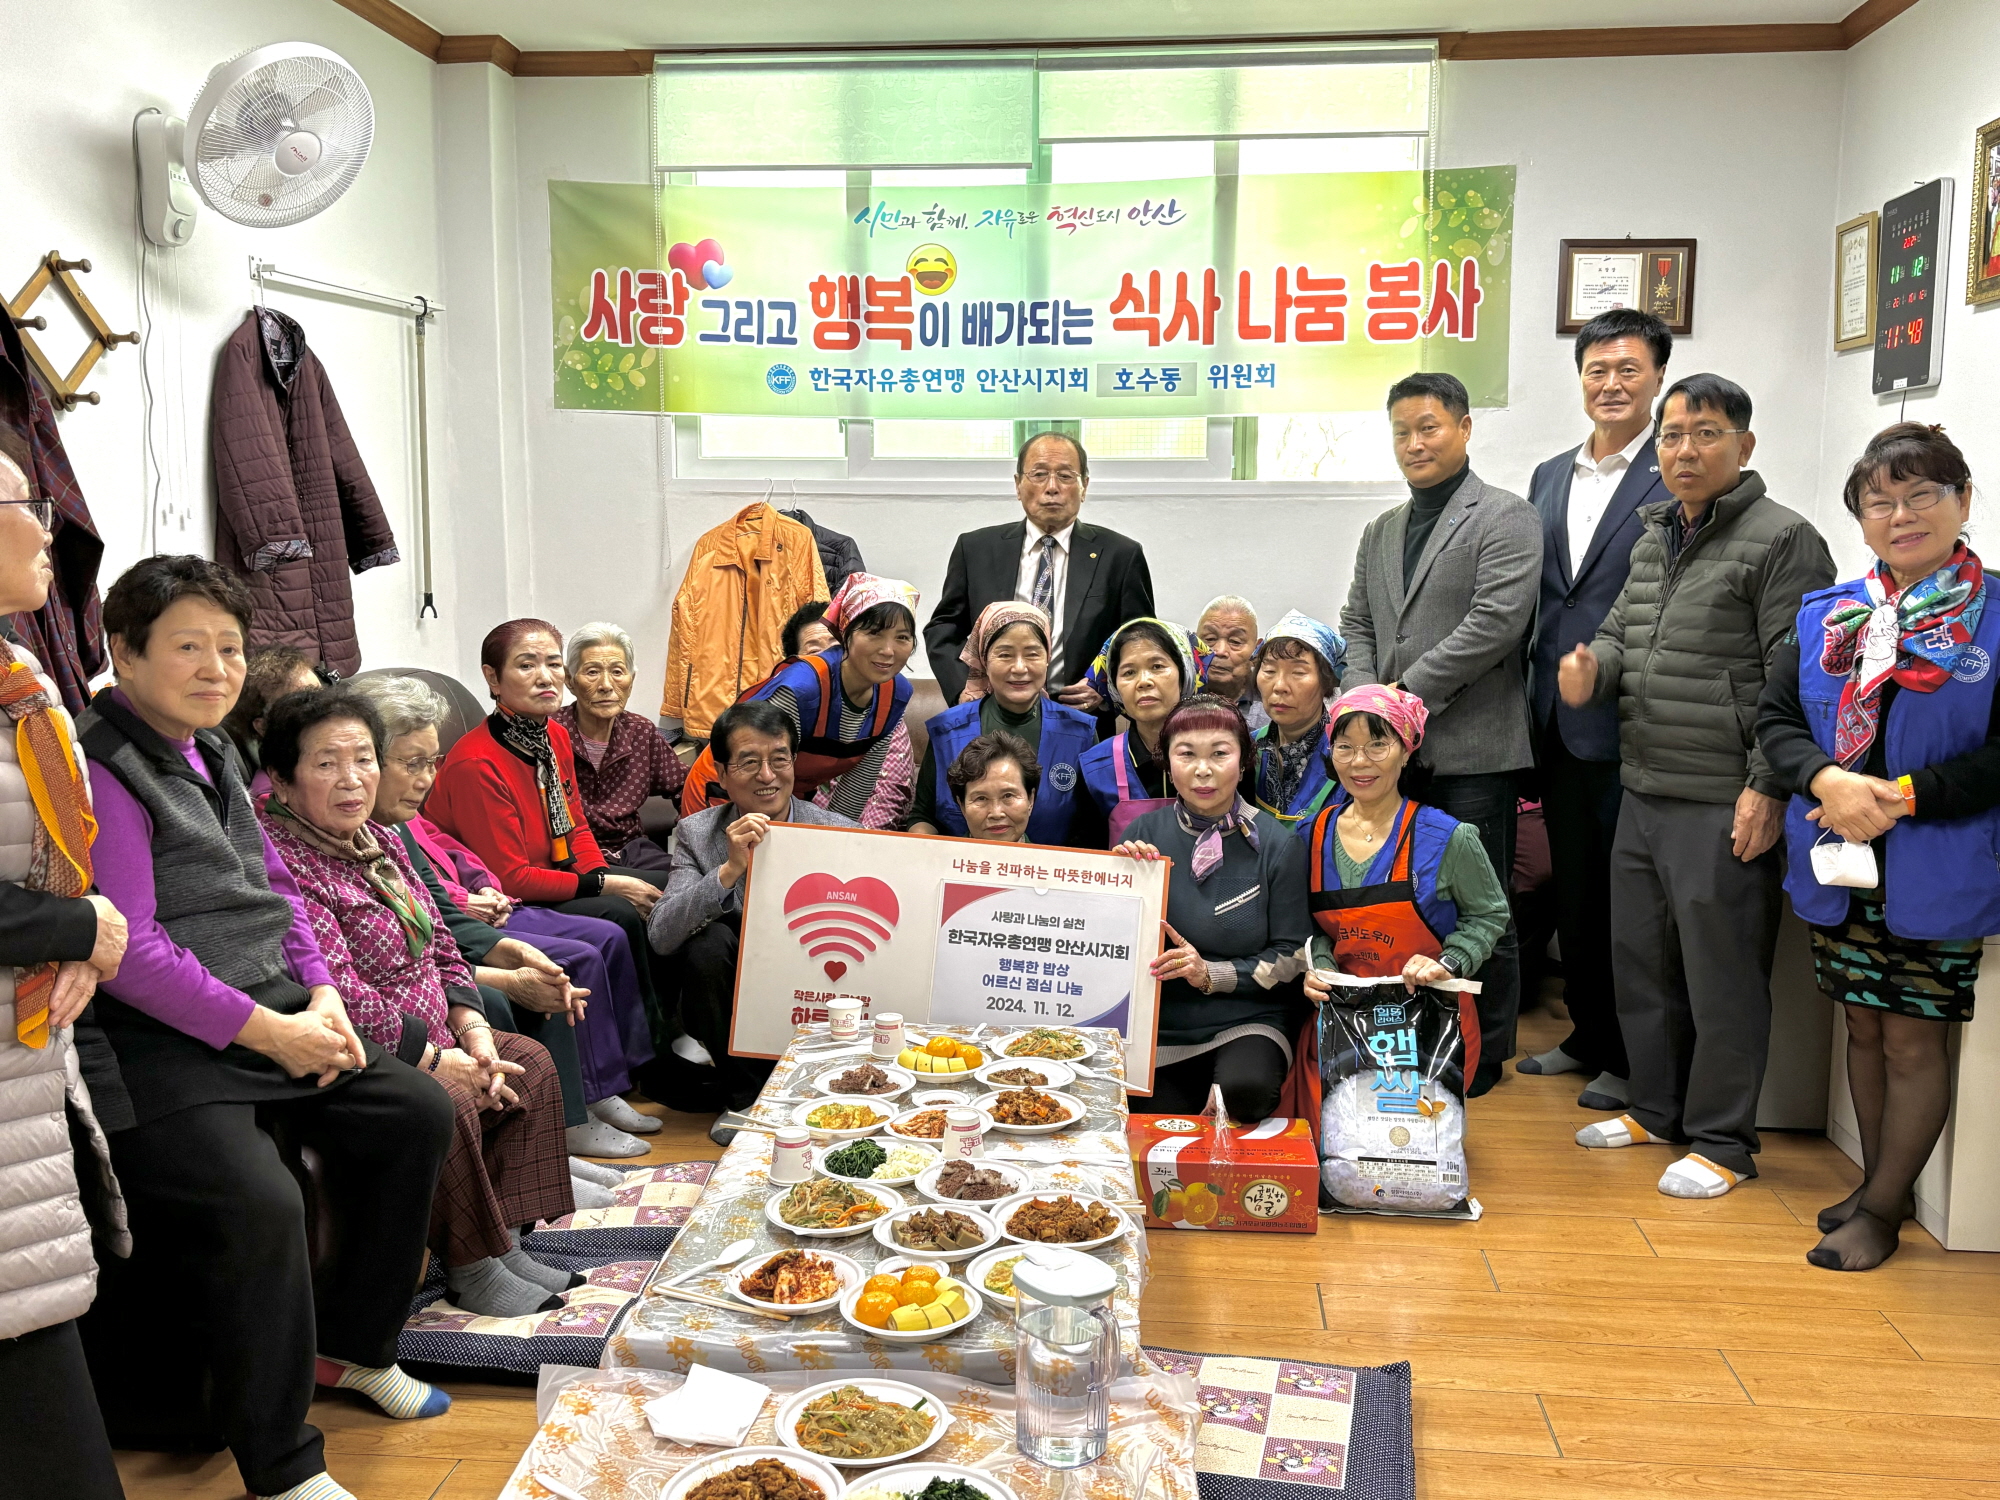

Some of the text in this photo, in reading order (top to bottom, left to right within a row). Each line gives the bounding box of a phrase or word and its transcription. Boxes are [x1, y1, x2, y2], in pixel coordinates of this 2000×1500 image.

[854, 201, 920, 238] 시민과
[974, 207, 1040, 239] 자유로운
[1046, 204, 1120, 236] 혁신도시
[1127, 199, 1187, 226] 안산
[1911, 255, 1924, 277] 12
[581, 258, 1483, 350] 사랑 그리고 행복이 배가되는 식사 나눔 봉사
[1887, 317, 1924, 350] 11:48
[772, 376, 791, 385] KFF
[809, 368, 965, 393] 한국자유총연맹
[976, 366, 1088, 394] 안산시지회
[1112, 365, 1182, 393] 호수동
[1207, 362, 1276, 390] 위원회
[952, 858, 1132, 888] 나눔을 전파하는 따뜻한에너지
[826, 890, 857, 902] ANSAN
[991, 911, 1085, 930] 사랑과 나눔의 실천
[948, 928, 1130, 960] 한국자유총연맹 안산시지회
[1339, 927, 1395, 949] 급식도우미
[999, 957, 1070, 977] 행복한 밥상
[982, 974, 1083, 996] 어르신 점심 나눔
[986, 996, 1075, 1017] 2024. 11. 12.
[1368, 1029, 1426, 1113] 햅쌀
[1446, 1161, 1460, 1172] 10kg
